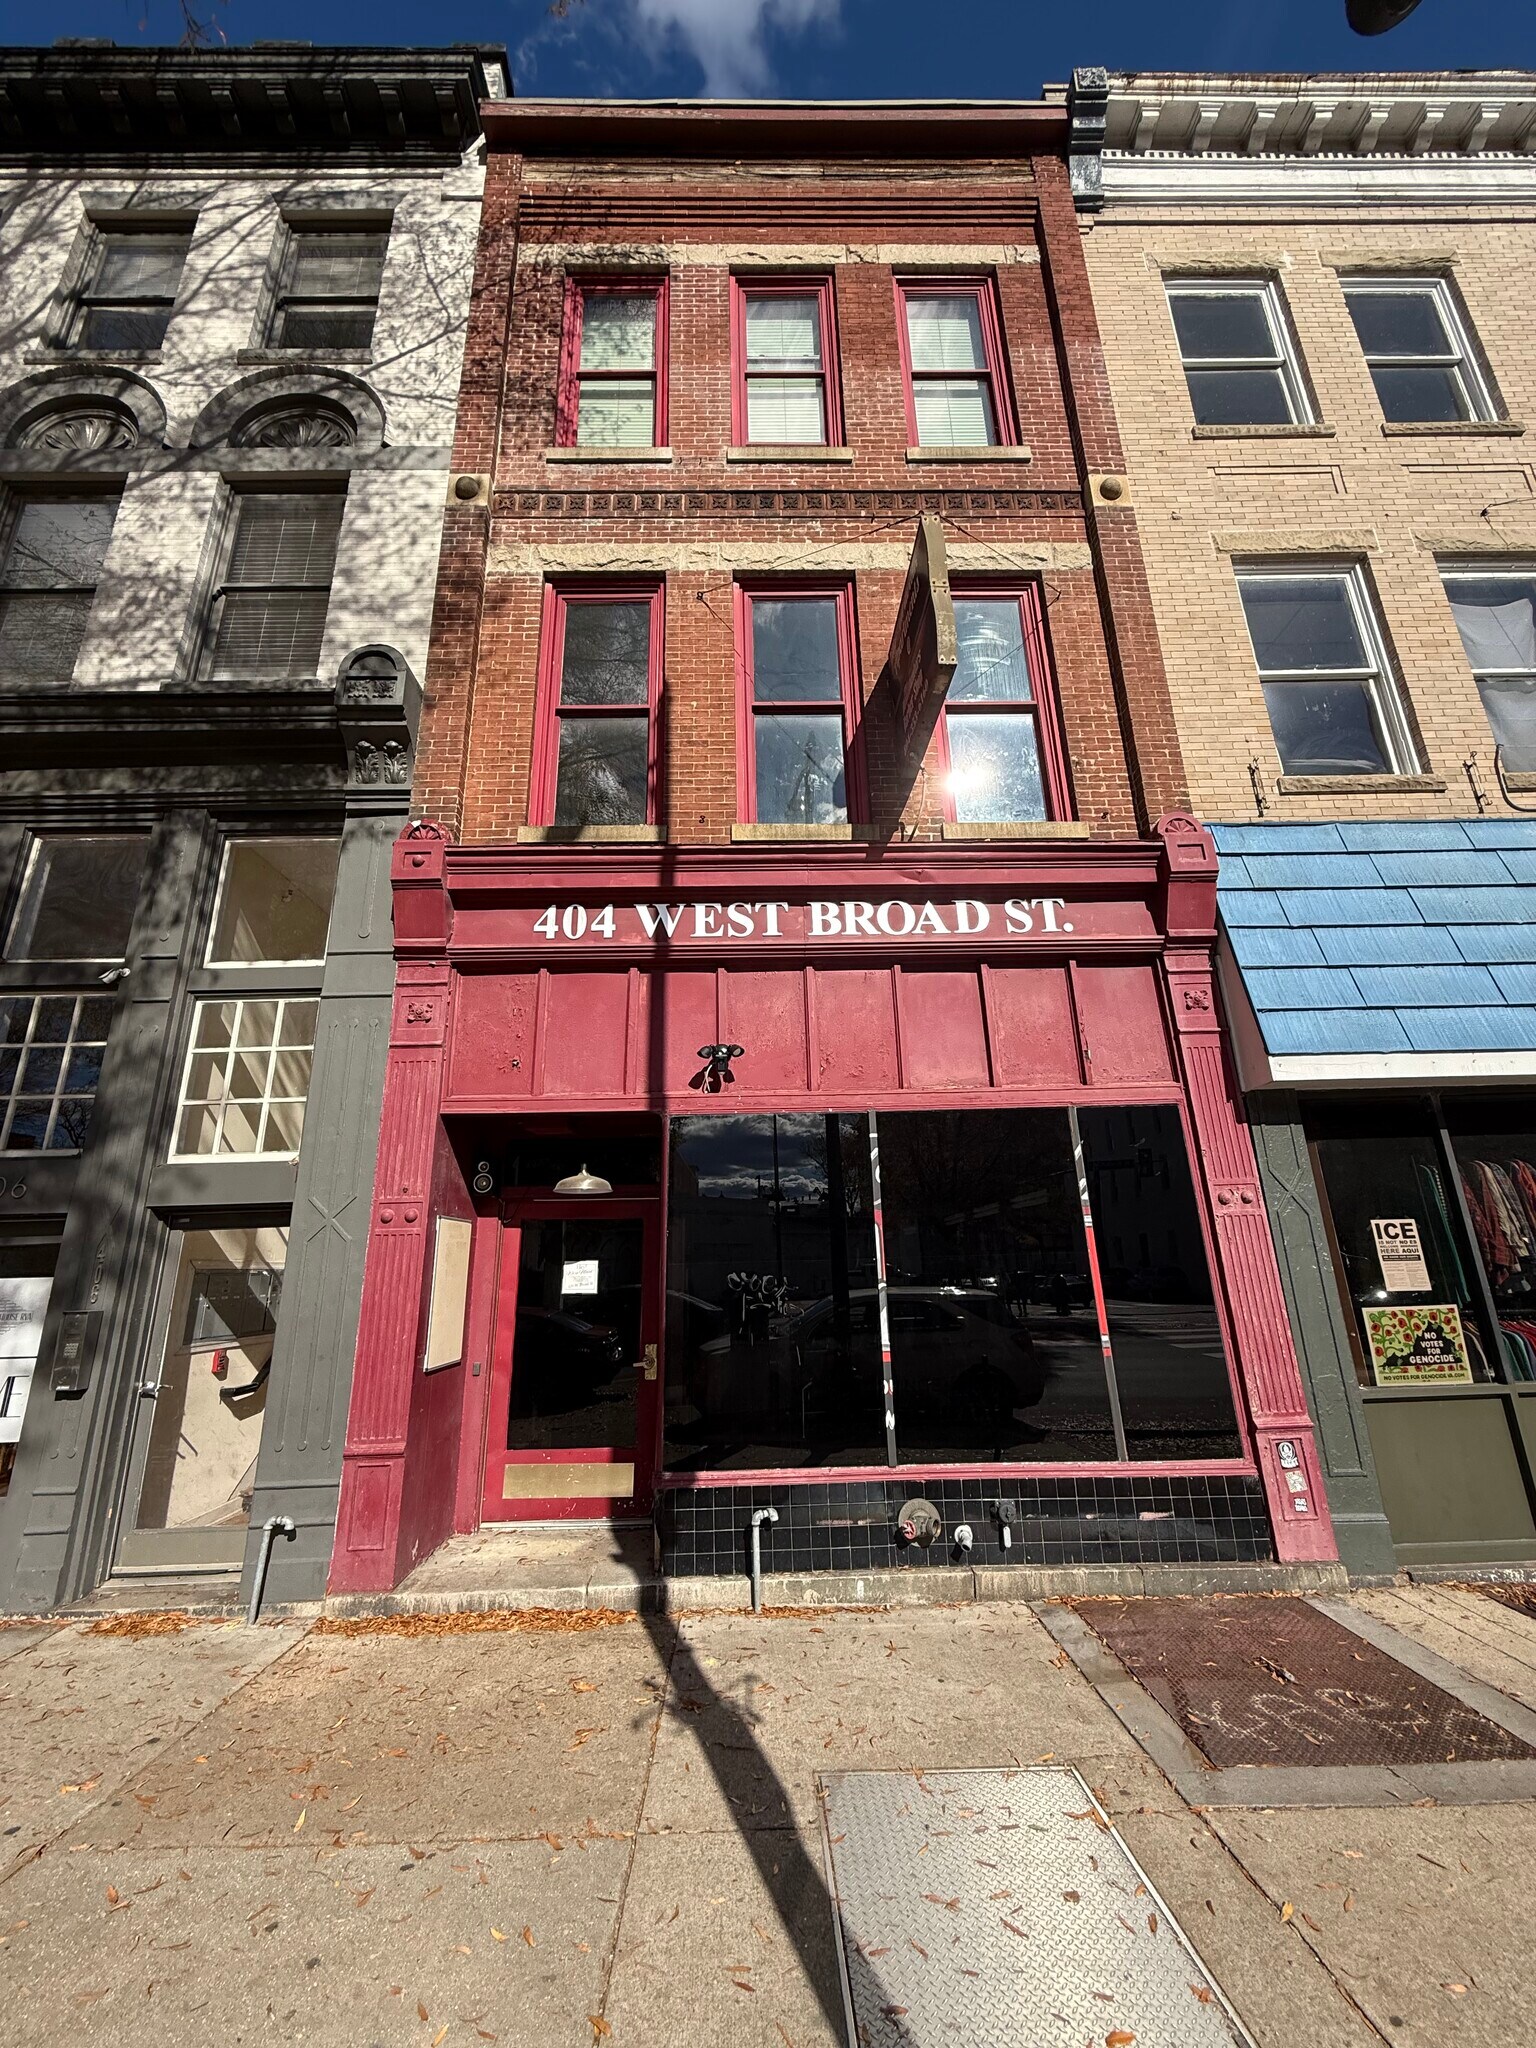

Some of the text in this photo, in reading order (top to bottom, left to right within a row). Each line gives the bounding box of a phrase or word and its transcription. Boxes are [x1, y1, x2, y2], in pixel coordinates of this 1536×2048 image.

[533, 898, 1075, 940] 404 WEST BROAD ST.
[1374, 1222, 1417, 1240] ICE
[1423, 1331, 1438, 1340] NO
[1420, 1340, 1444, 1349] VOTES
[1409, 1354, 1455, 1364] GENOCIDE
